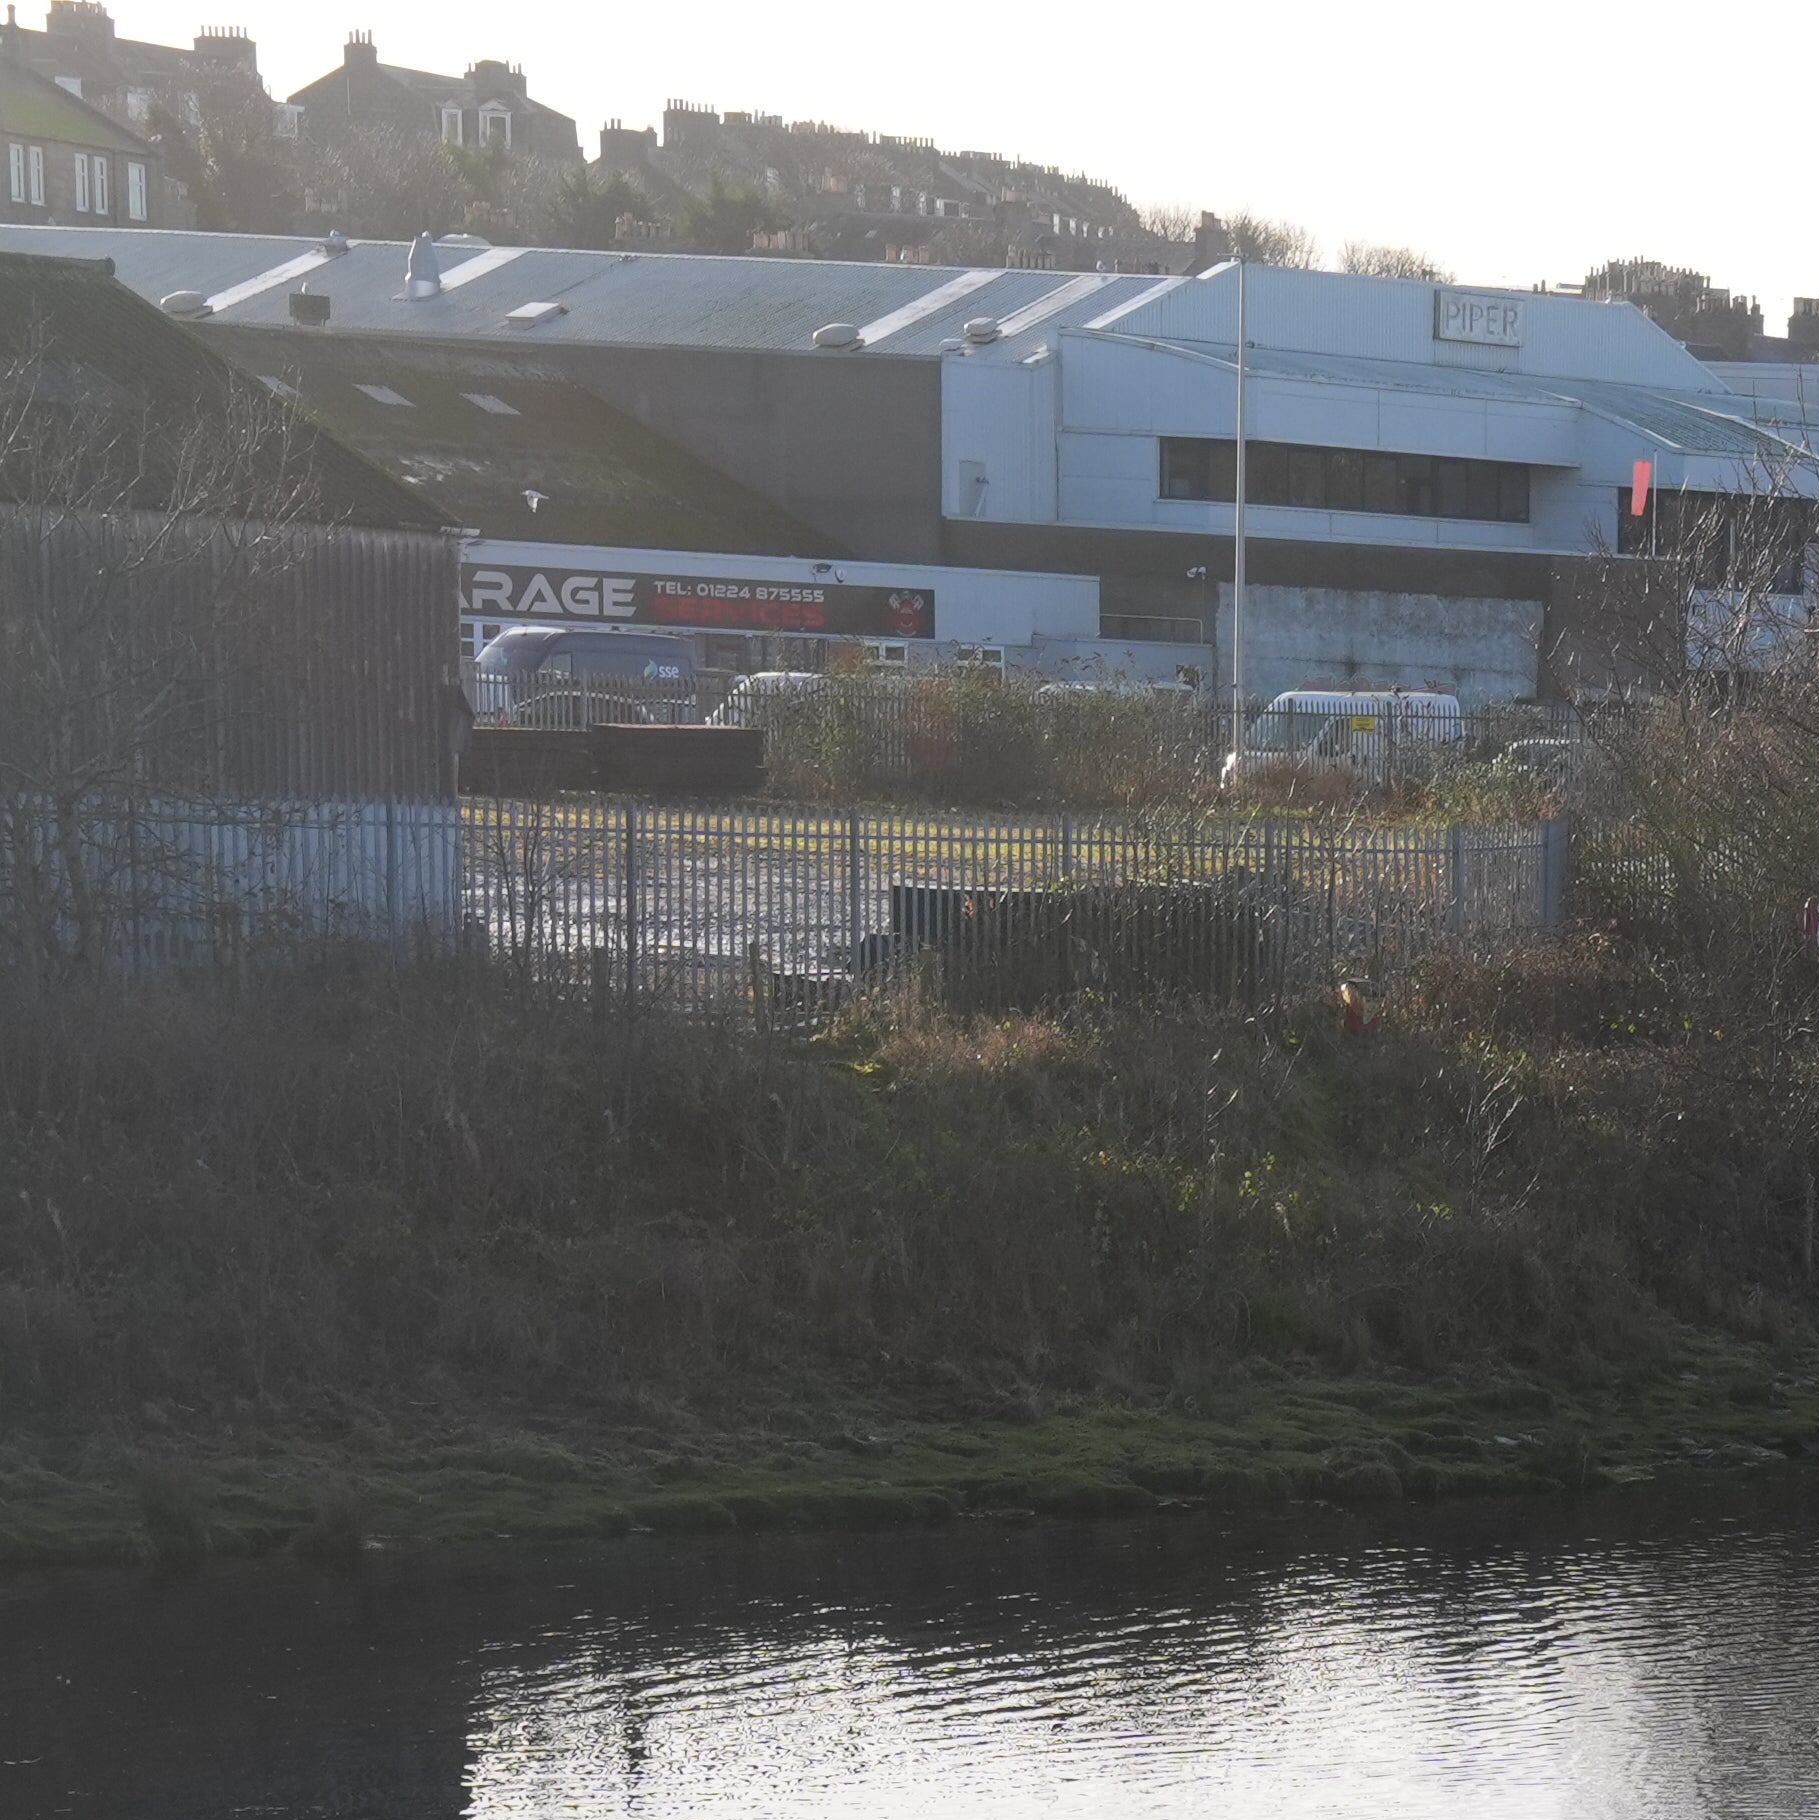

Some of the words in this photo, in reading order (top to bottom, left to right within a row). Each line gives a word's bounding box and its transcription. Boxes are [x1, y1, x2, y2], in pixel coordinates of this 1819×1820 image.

[1446, 301, 1518, 337] PIPER
[460, 570, 637, 617] RAGE
[653, 580, 691, 596] TEL:
[697, 583, 750, 599] 01224
[755, 586, 824, 603] 875555
[655, 596, 825, 627] SERVICES
